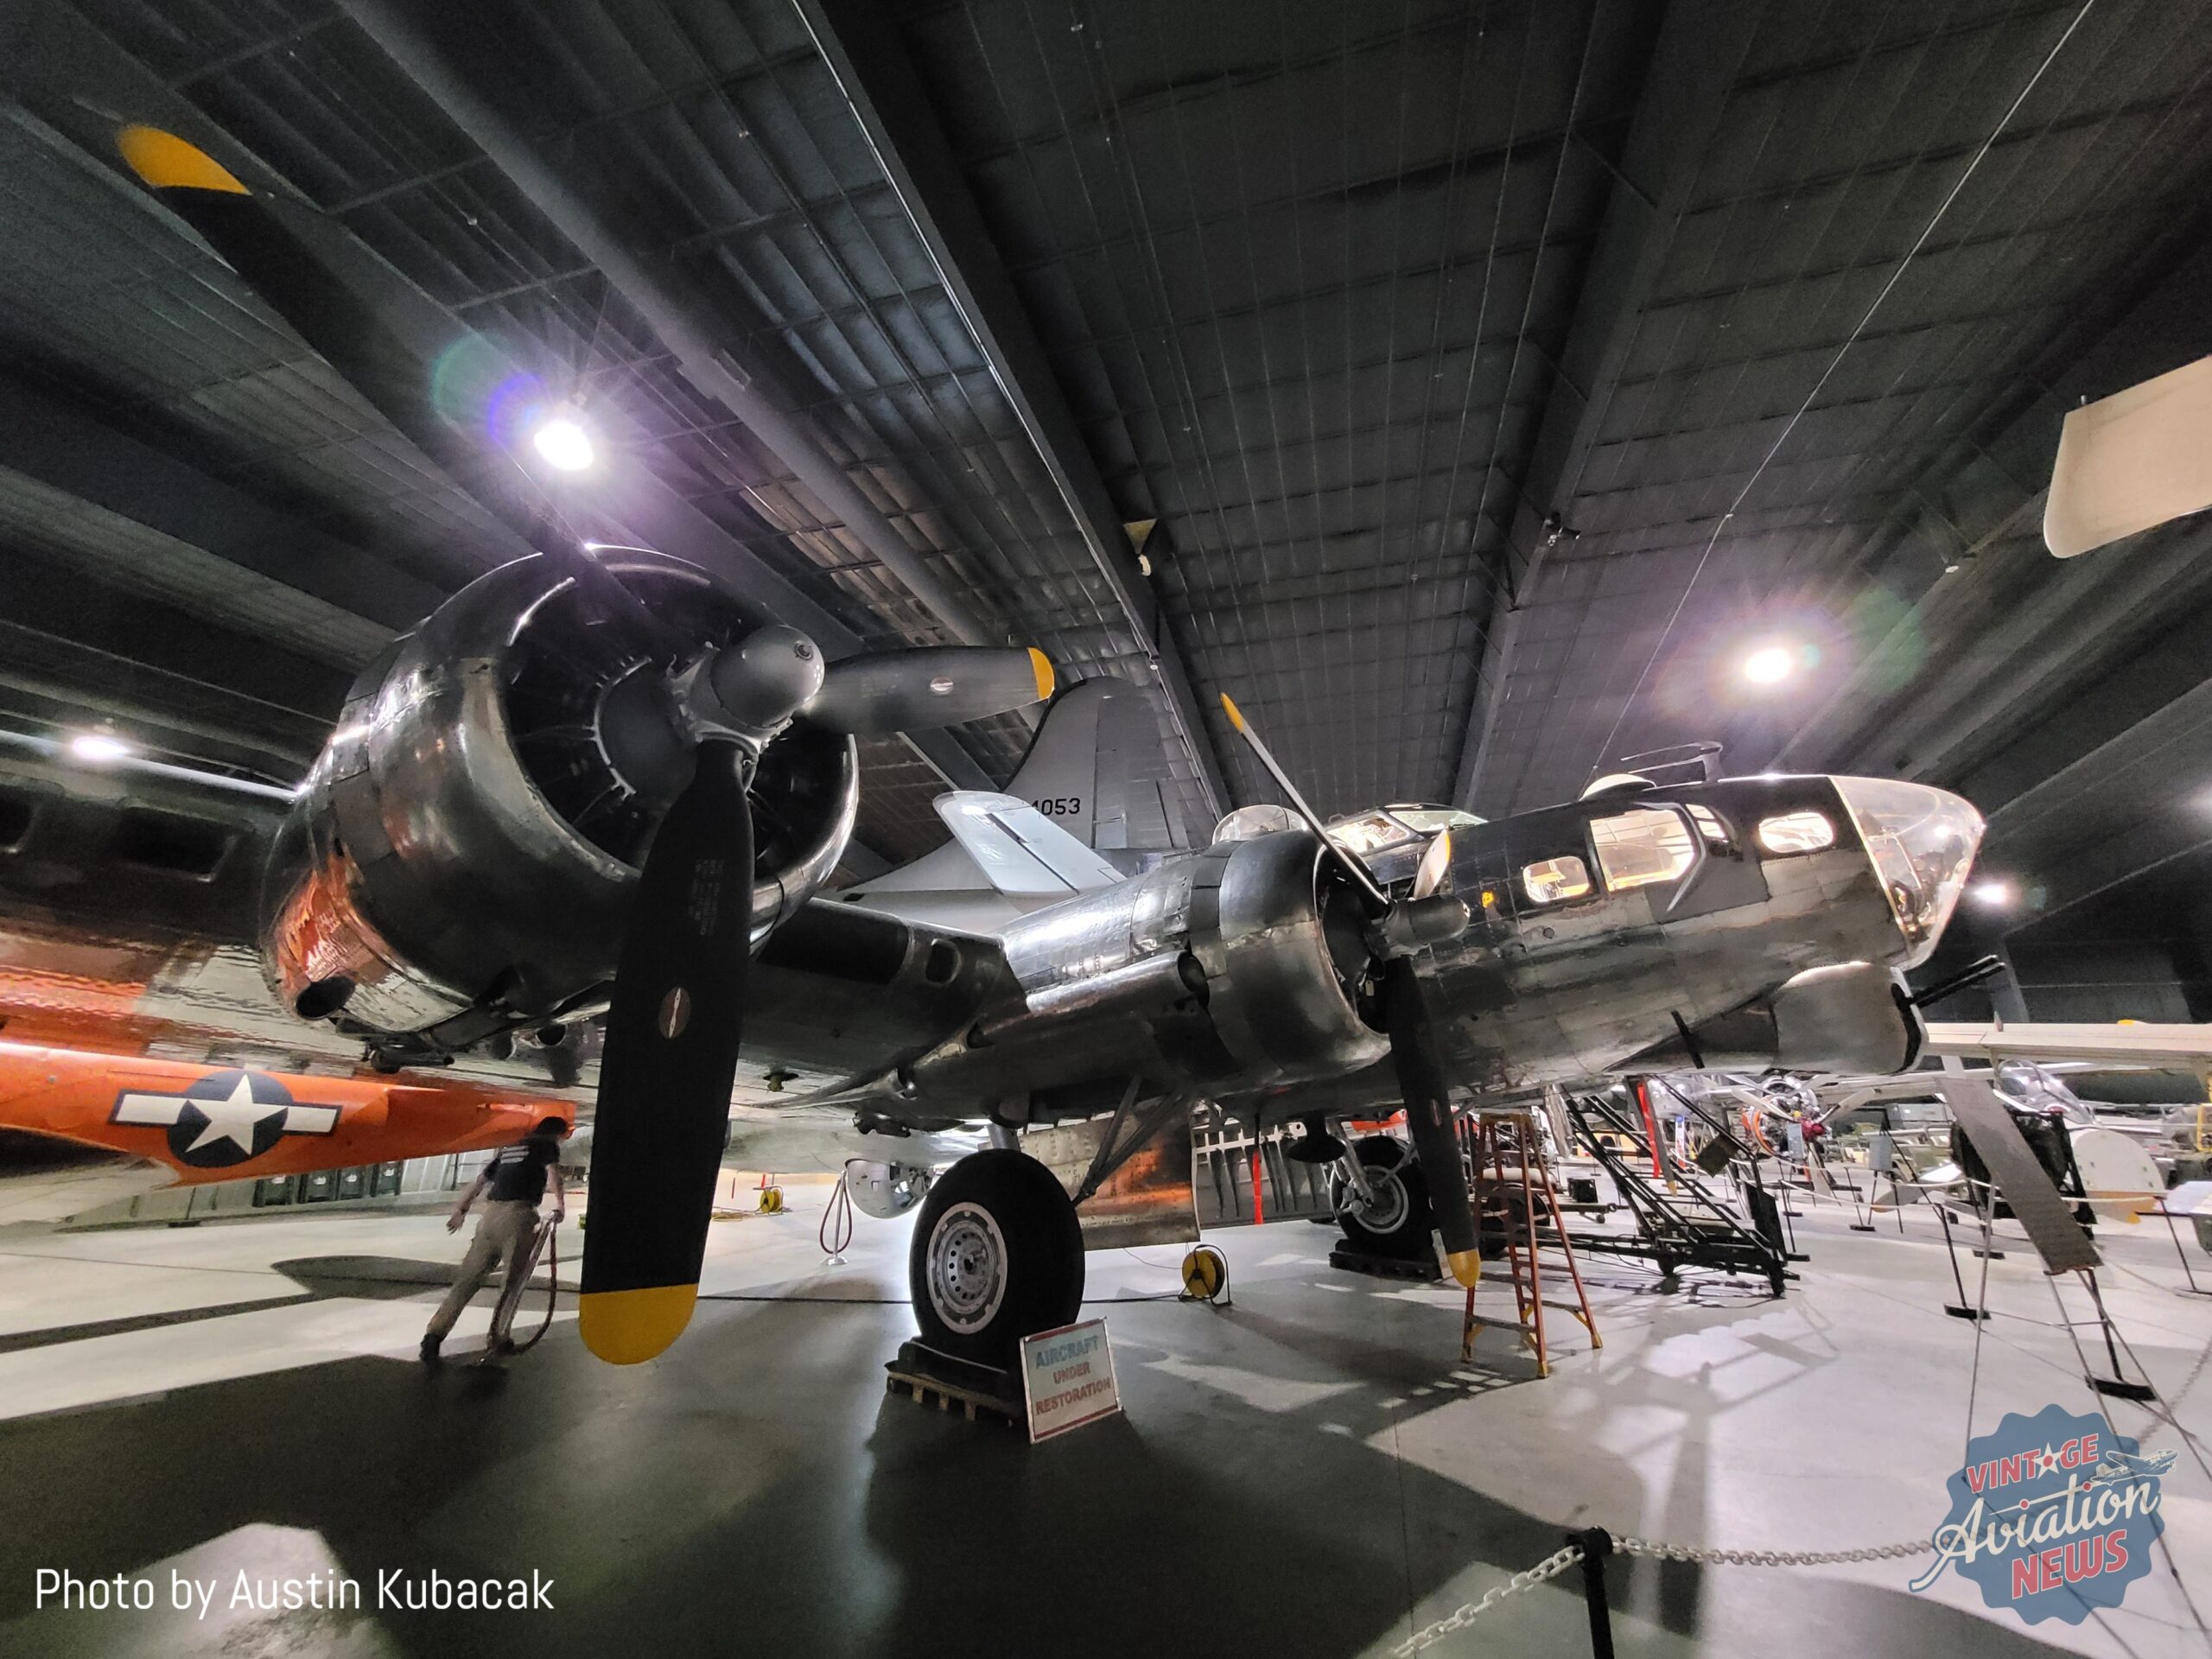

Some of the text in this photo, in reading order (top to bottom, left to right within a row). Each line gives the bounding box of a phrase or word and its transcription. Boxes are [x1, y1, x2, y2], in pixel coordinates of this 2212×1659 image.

[1036, 1336, 1098, 1369] AIRCRAFT
[1052, 1362, 1090, 1384] UNDER
[1036, 1377, 1111, 1414] RESTORATION
